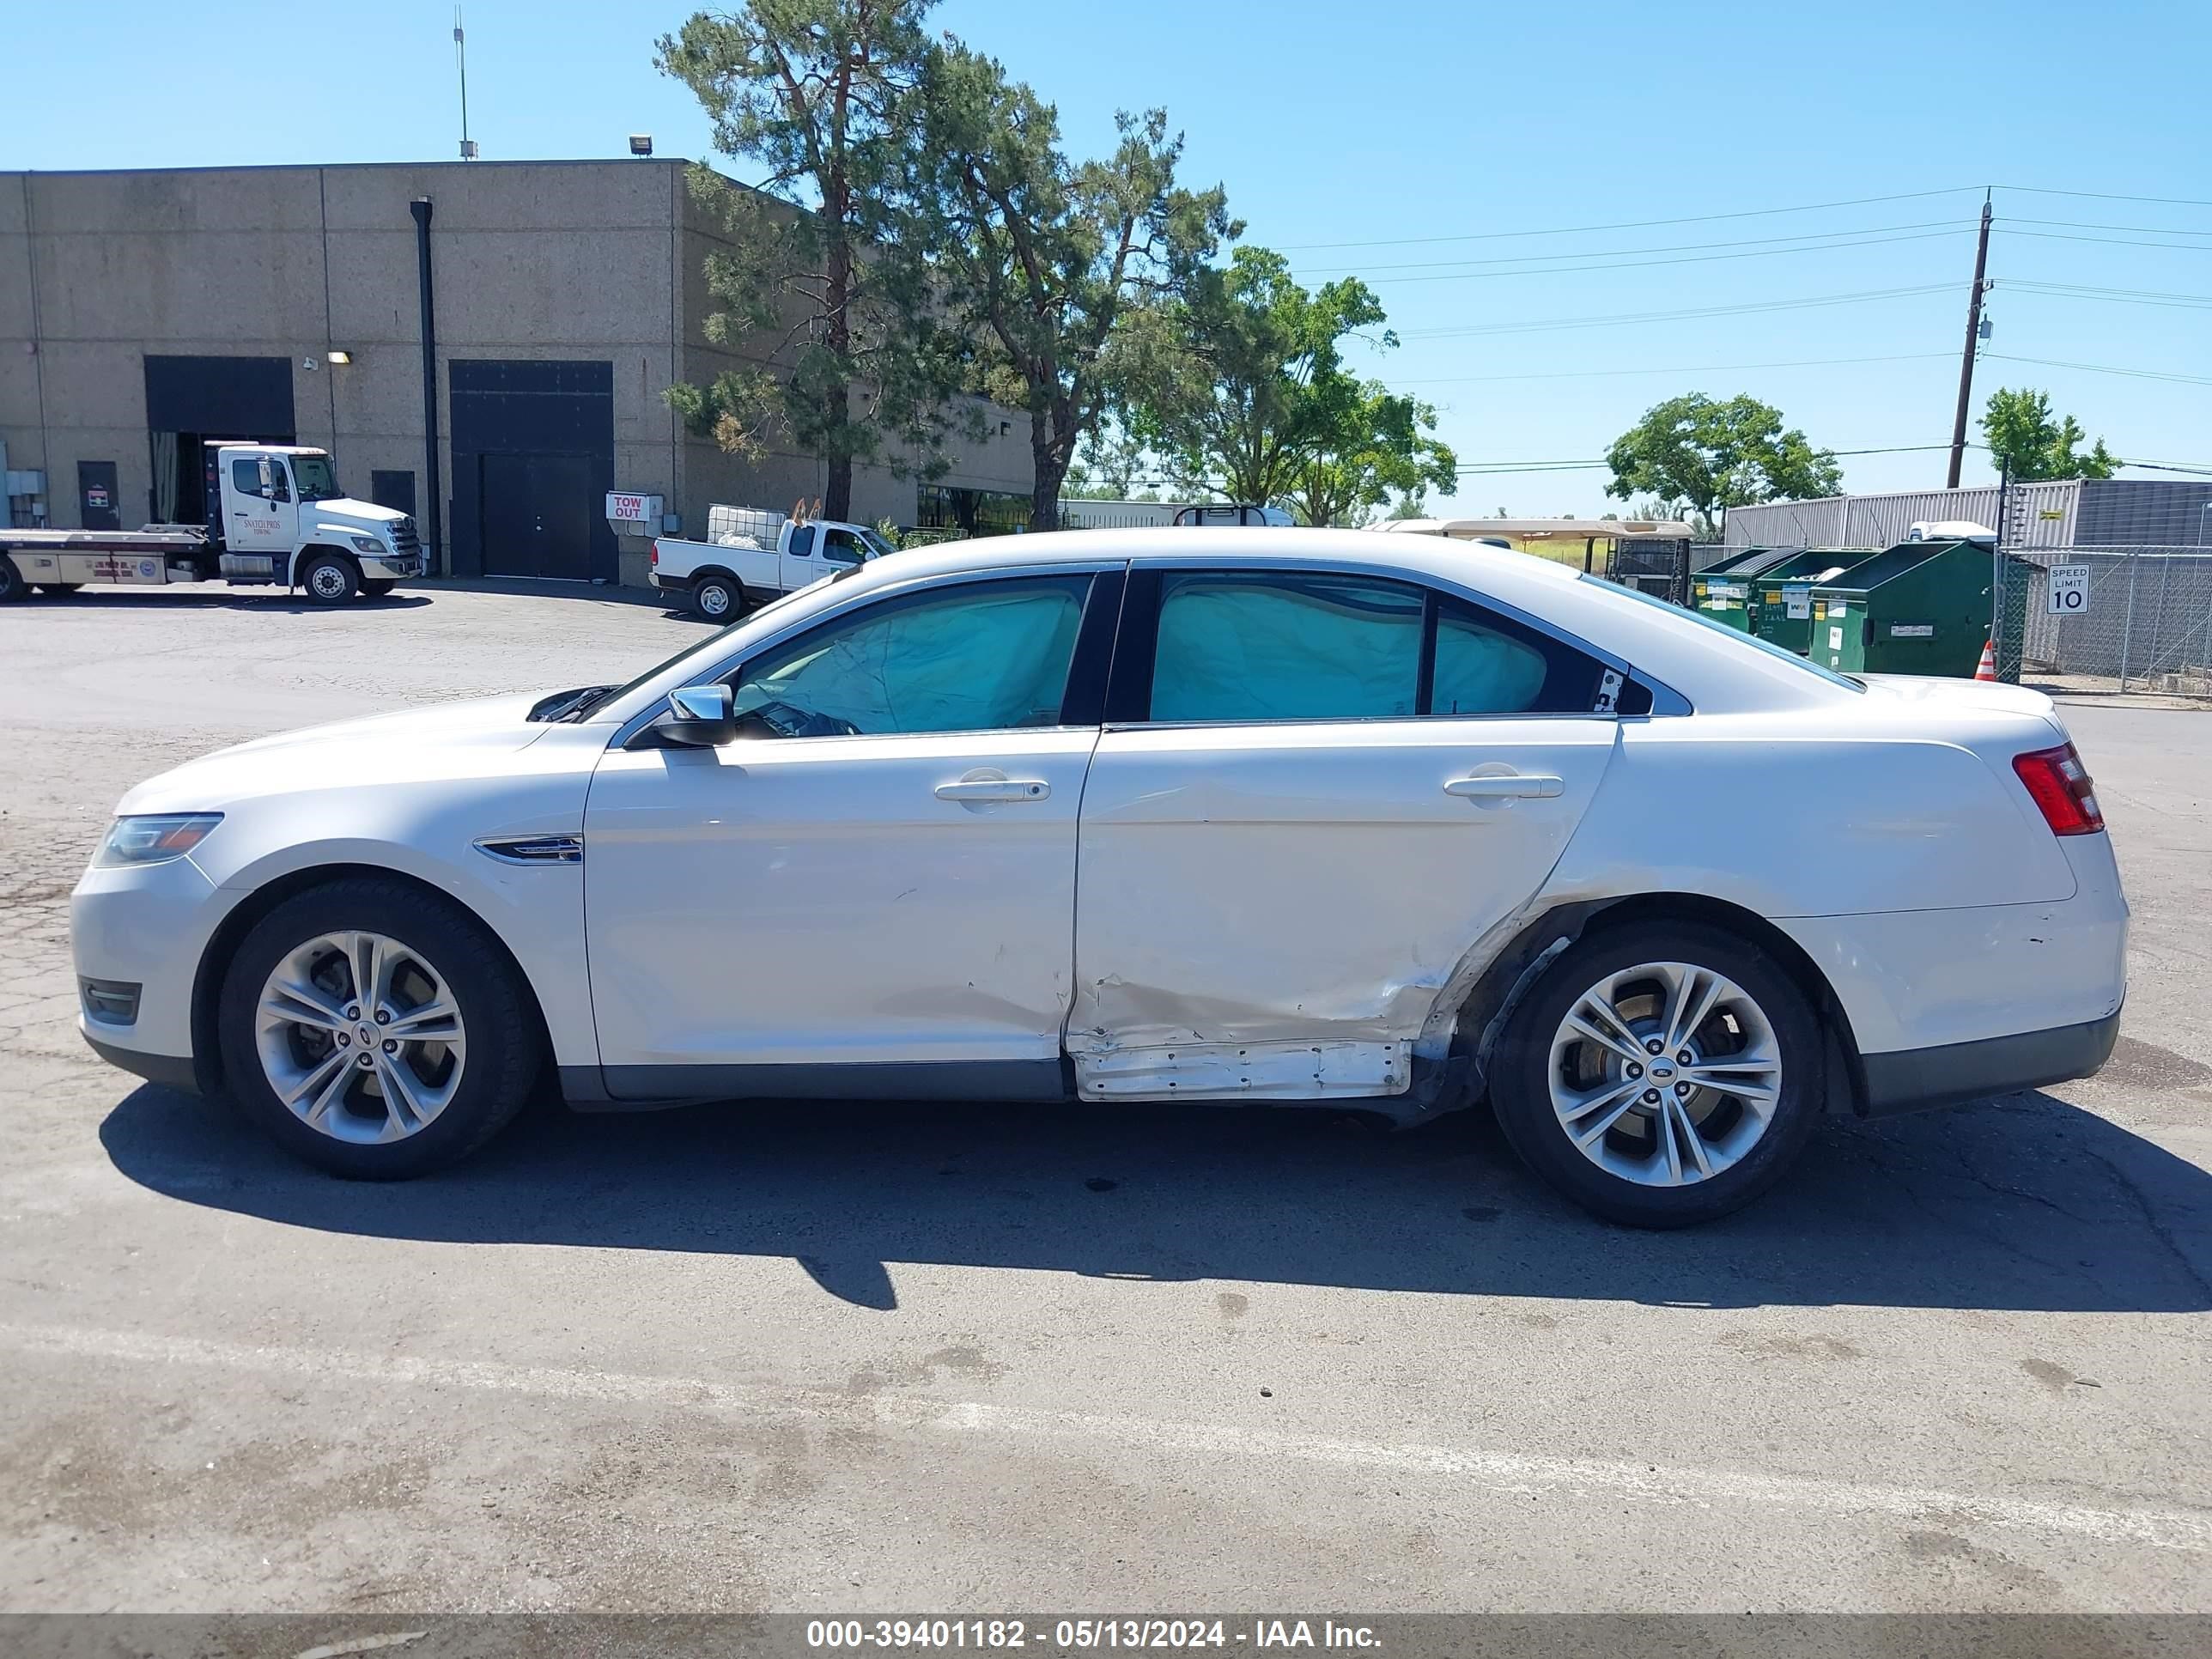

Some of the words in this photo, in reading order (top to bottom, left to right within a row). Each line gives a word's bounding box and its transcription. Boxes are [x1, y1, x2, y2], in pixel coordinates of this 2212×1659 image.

[614, 497, 641, 508] TOW
[616, 507, 641, 518] OUT
[2052, 568, 2087, 578] SPEED
[2055, 580, 2082, 588] LIMIT
[2054, 591, 2082, 609] 10
